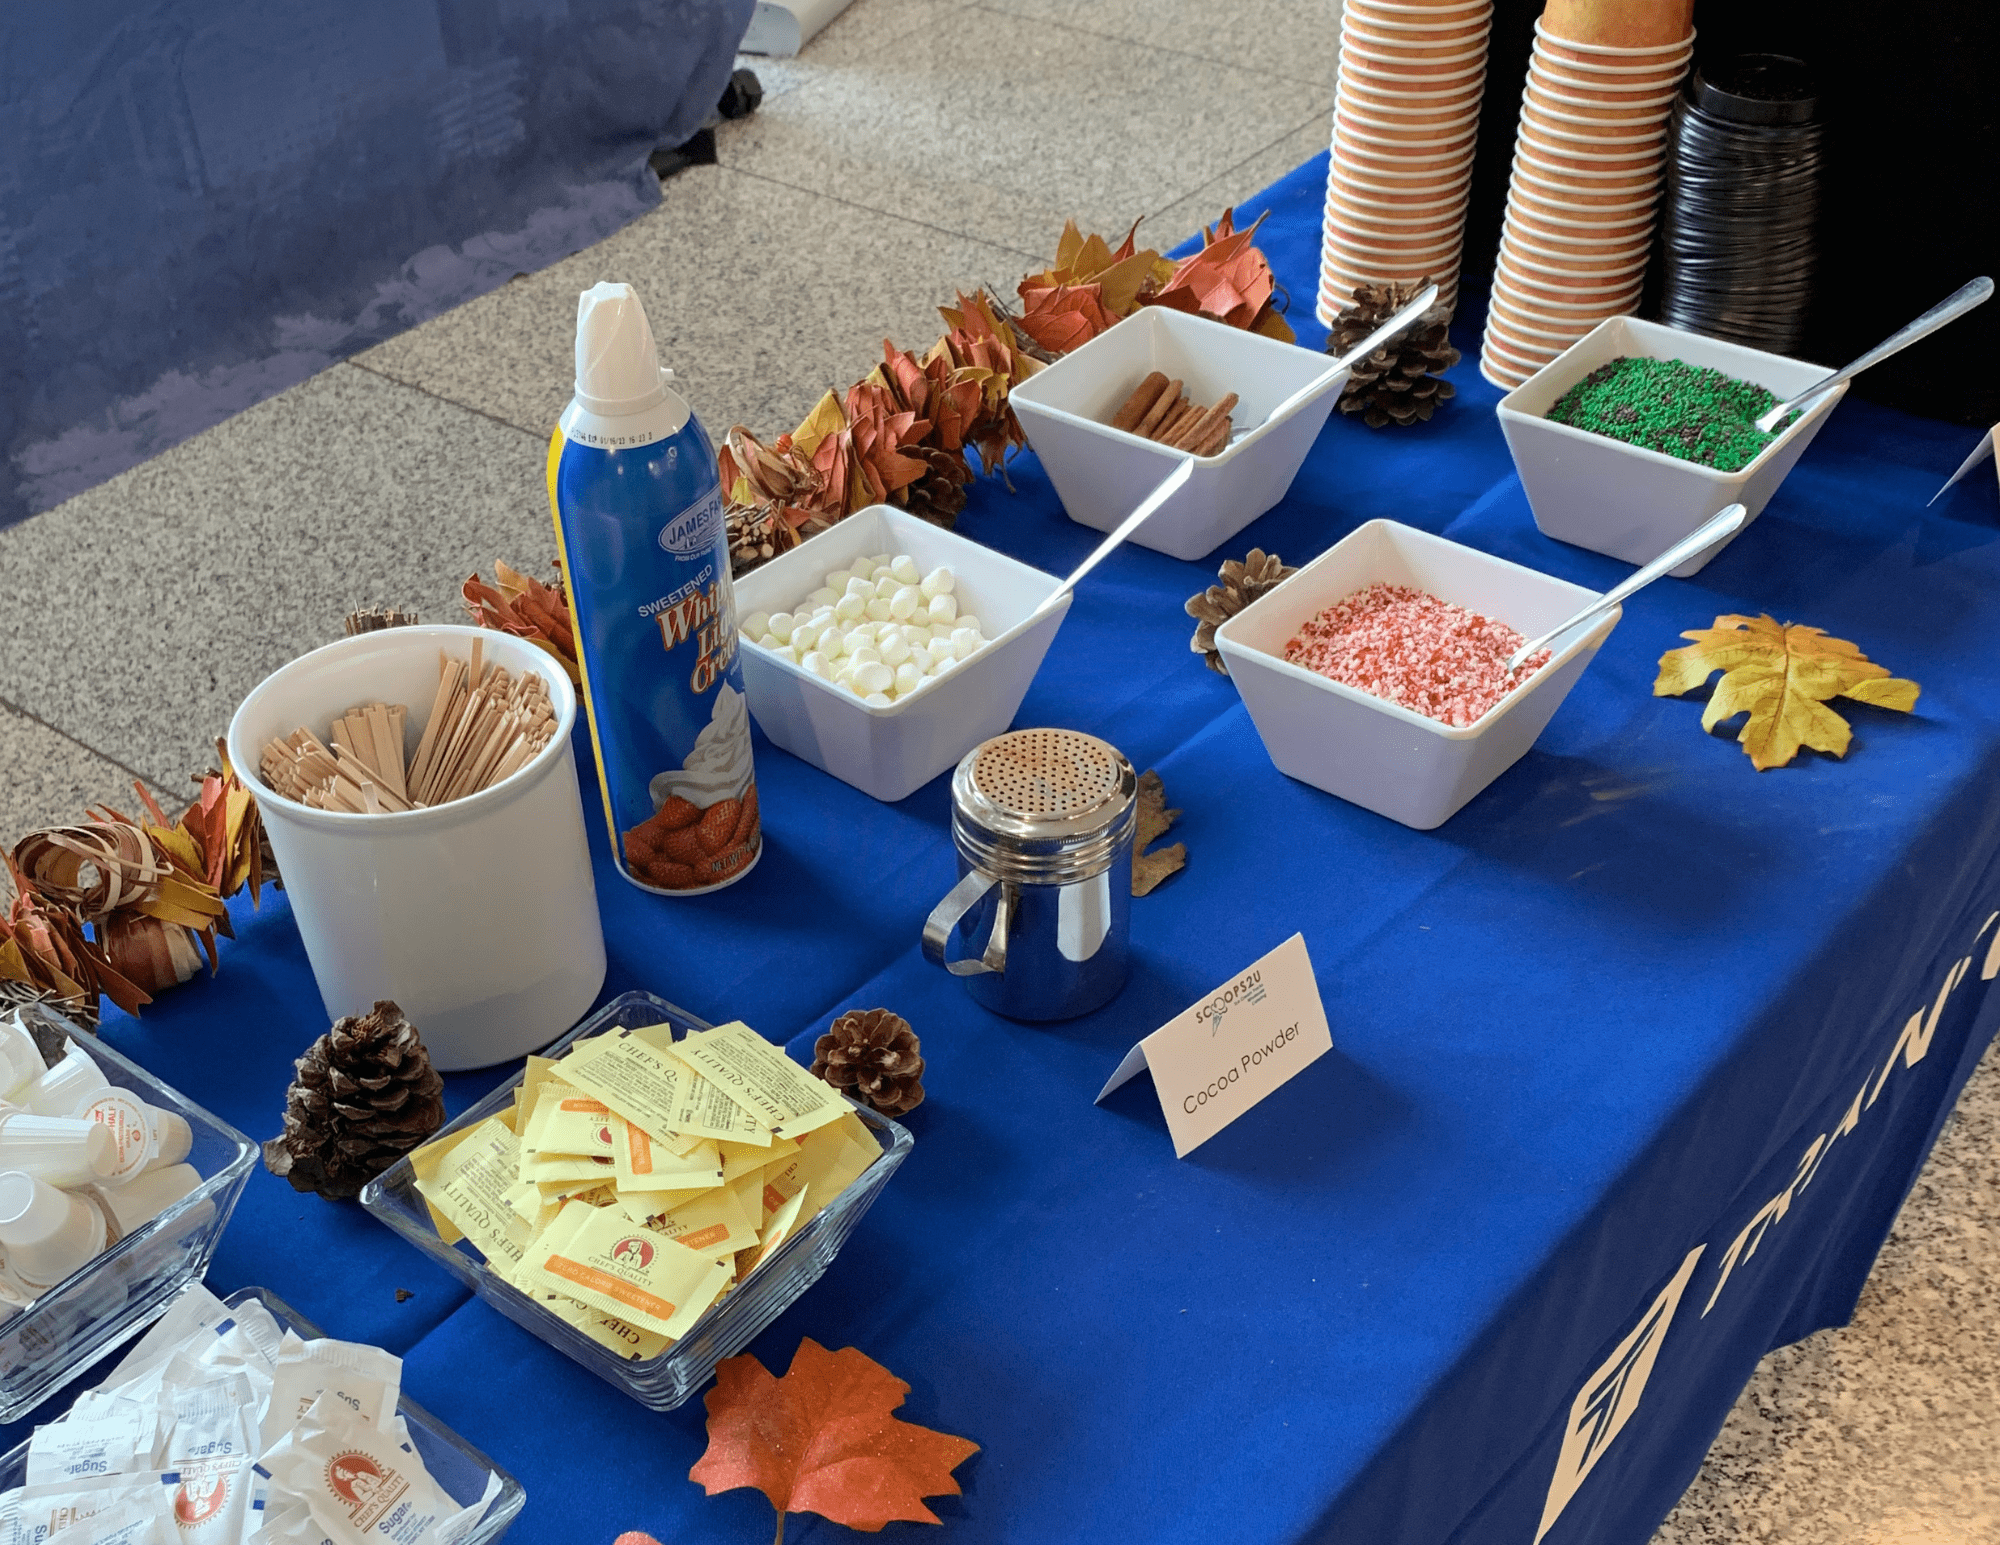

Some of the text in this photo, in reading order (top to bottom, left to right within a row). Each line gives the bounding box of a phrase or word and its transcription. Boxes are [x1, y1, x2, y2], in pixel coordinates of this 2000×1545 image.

[668, 509, 710, 545] JAMES
[638, 564, 713, 618] SWEETENED
[1196, 969, 1261, 1024] SCOOPS2U
[618, 1042, 664, 1070] CHEF'S
[692, 1048, 744, 1087] QUALITY
[1183, 1021, 1300, 1114] Cocoa Powder
[743, 1086, 786, 1122] CHEF'S
[440, 1181, 491, 1229] QUALITY
[588, 1255, 653, 1288] CHEF'S QUALITY
[193, 1441, 232, 1456] Sugar
[69, 1460, 107, 1475] Sugar
[353, 1473, 405, 1528] CHEF'S QUALITY
[378, 1502, 410, 1534] Sugar
